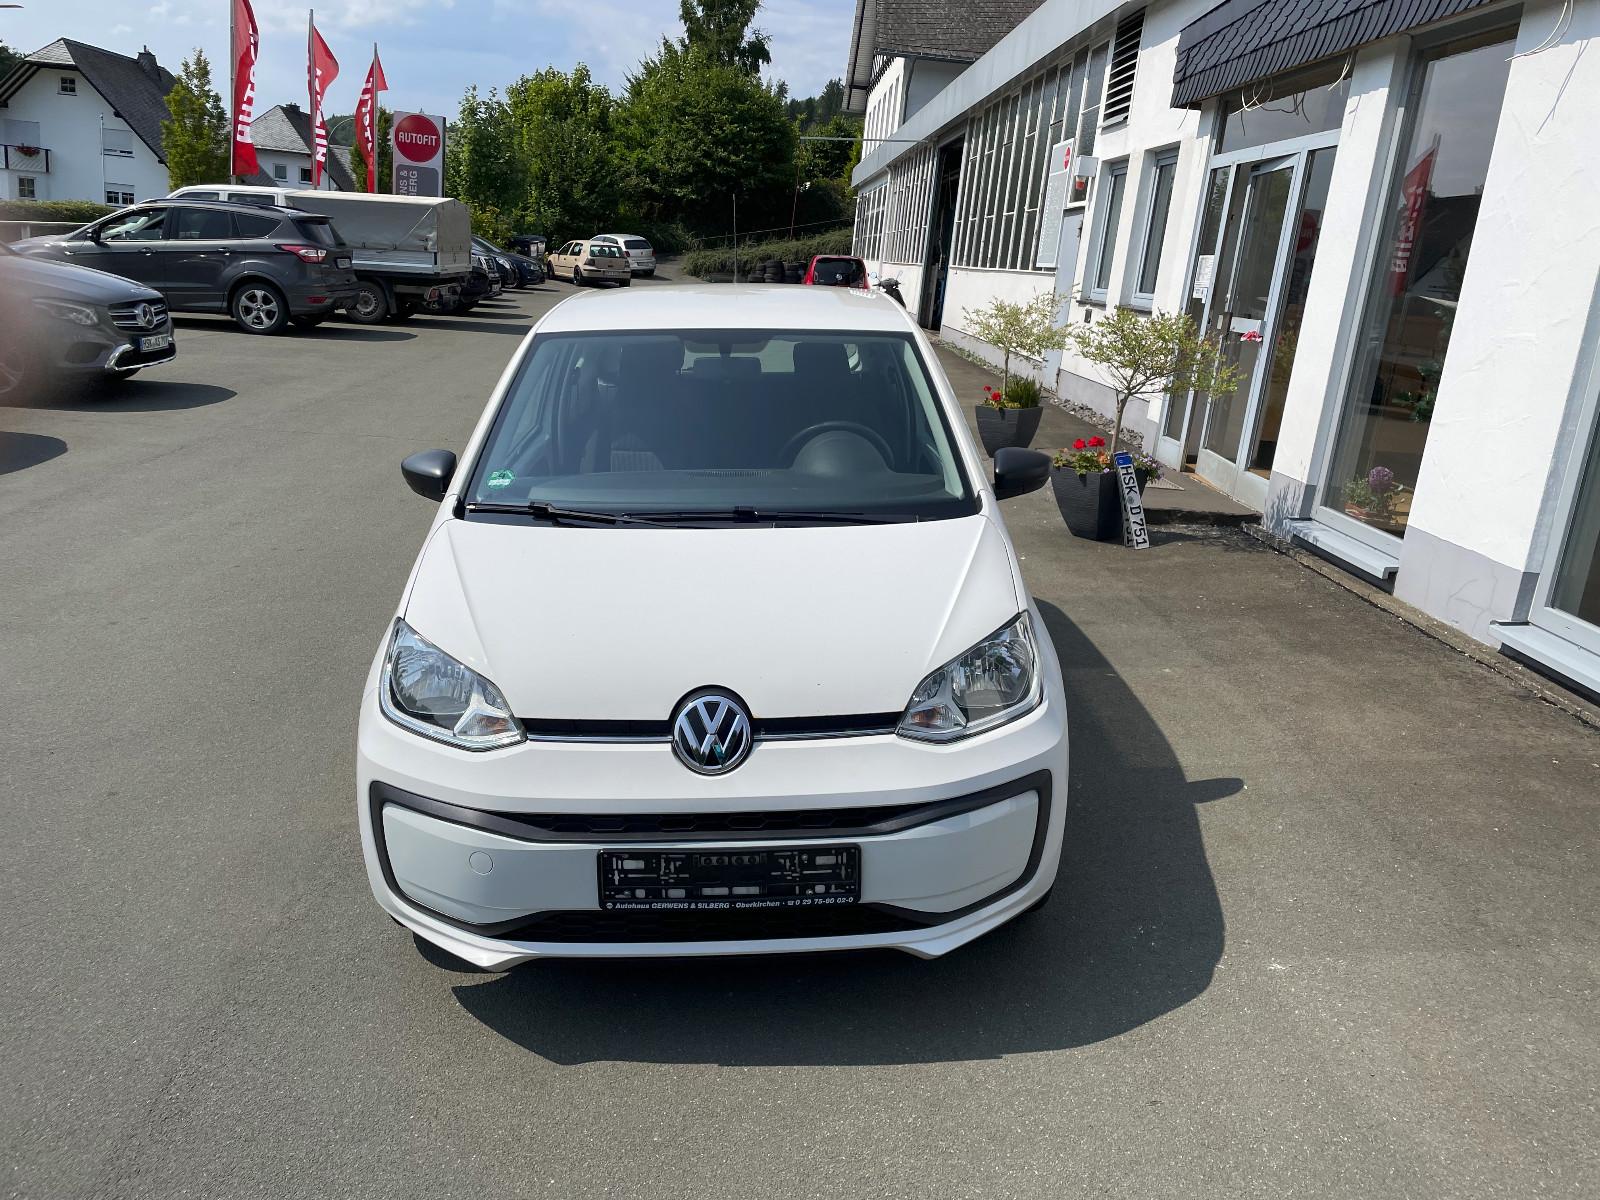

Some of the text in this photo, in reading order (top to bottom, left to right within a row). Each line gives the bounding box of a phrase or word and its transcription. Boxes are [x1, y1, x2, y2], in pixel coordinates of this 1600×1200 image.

[398, 131, 438, 147] AUTOFIT
[1120, 465, 1148, 548] HSK D 751
[735, 900, 780, 909] Oberkirchen
